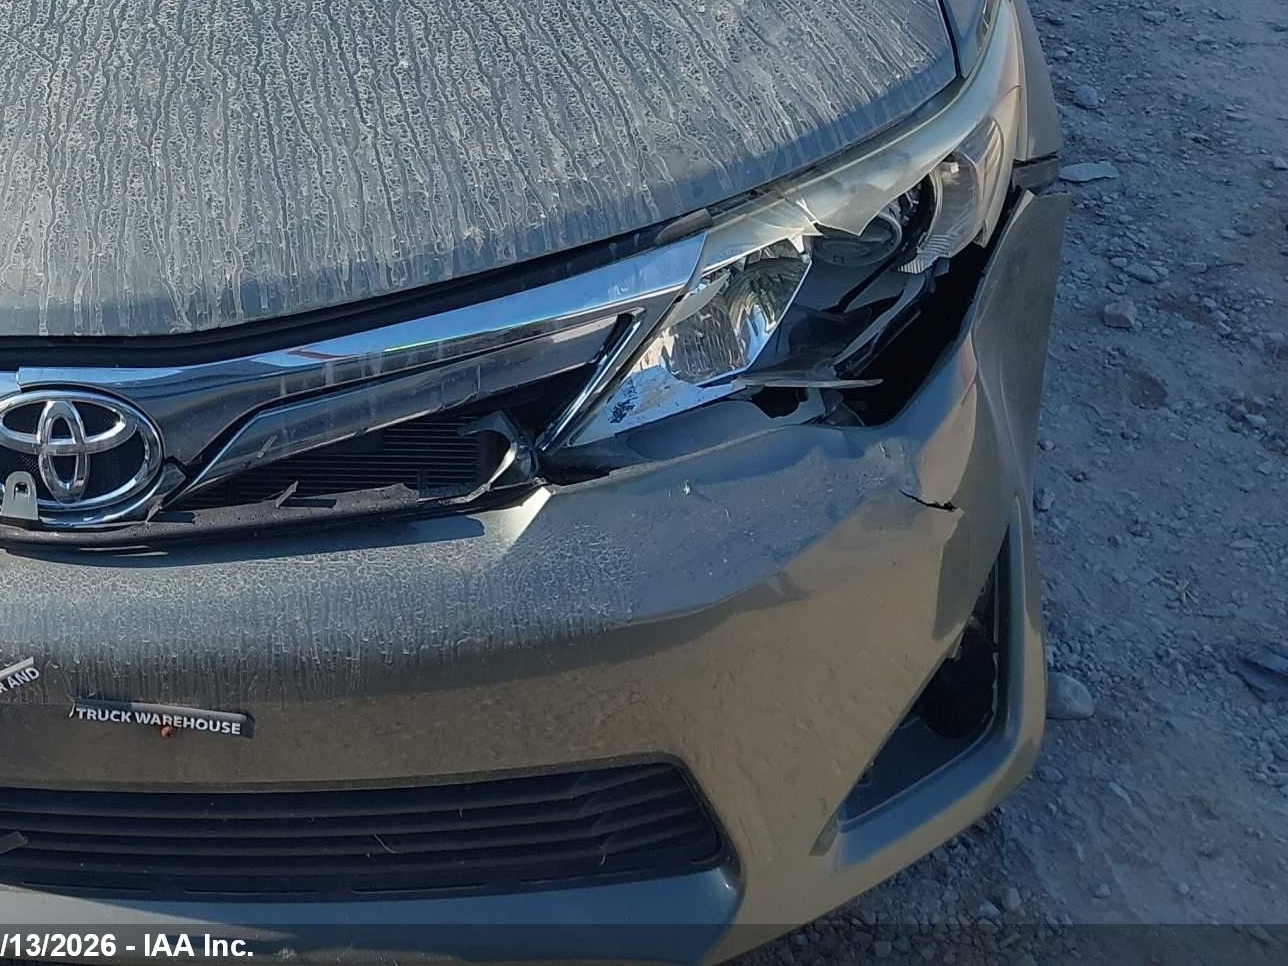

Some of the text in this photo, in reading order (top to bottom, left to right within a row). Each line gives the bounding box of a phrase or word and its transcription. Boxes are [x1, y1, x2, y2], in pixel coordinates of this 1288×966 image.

[7, 667, 41, 689] AND
[76, 707, 241, 735] TRUCK WAREHOUSE
